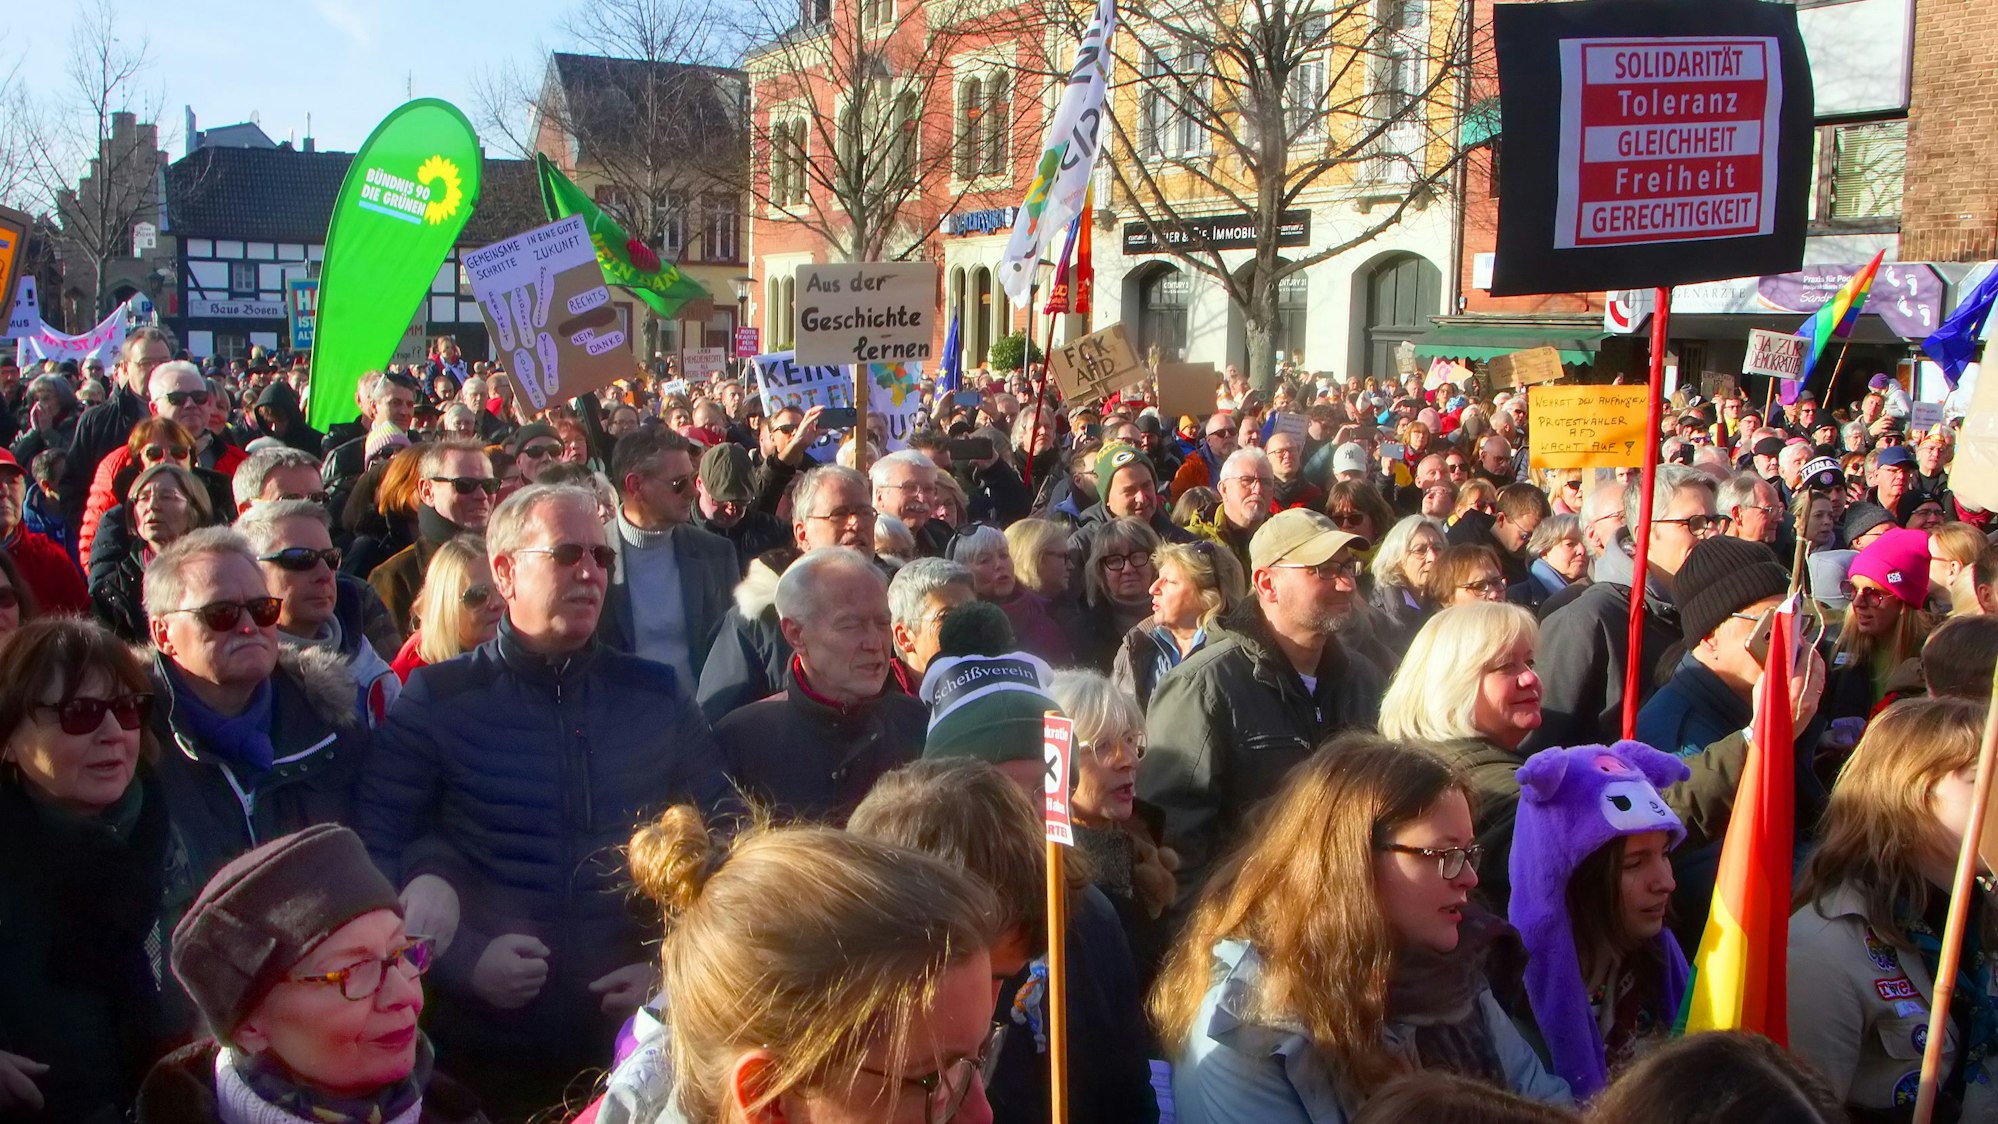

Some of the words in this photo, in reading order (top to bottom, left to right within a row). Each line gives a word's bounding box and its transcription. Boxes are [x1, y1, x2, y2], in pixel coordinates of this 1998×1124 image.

[1615, 46, 1743, 79] SOLIDARITÄT
[1617, 88, 1738, 117] Toleranz
[1618, 126, 1737, 157] GLEICHHEIT
[365, 167, 415, 196] BÜNDNIS
[415, 184, 431, 201] 90
[1615, 161, 1735, 195] Freiheit
[360, 183, 382, 203] DIE
[382, 190, 427, 217] GRÜNEN
[1592, 198, 1753, 233] GERECHTIGKEIT
[527, 236, 537, 247] IN
[539, 228, 557, 243] EINE
[557, 220, 580, 236] GUTE
[1212, 225, 1257, 241] IMMOBIL
[466, 240, 521, 269] GEMEINSAME
[533, 235, 580, 261] ZUKUNFT
[476, 257, 518, 281] SCHRITTE
[806, 272, 841, 293] Aus
[850, 270, 898, 291] der
[1822, 273, 1831, 281] für
[210, 303, 240, 315] Haus
[568, 289, 607, 312] RECHTS
[1799, 291, 1833, 303] Sandr
[297, 315, 314, 329] IST
[801, 305, 922, 332] Geschichte
[572, 329, 594, 344] NEIN
[589, 334, 622, 354] DANKE
[852, 336, 930, 361] lernen
[1754, 334, 1772, 352] JA
[1775, 337, 1804, 358] ZUR
[1063, 335, 1111, 369] FCK
[1748, 350, 1802, 375] DEMOKRATIE
[1569, 428, 1596, 438] AFD
[1541, 442, 1585, 451] WACHT
[934, 665, 1034, 706] Scheißverein
